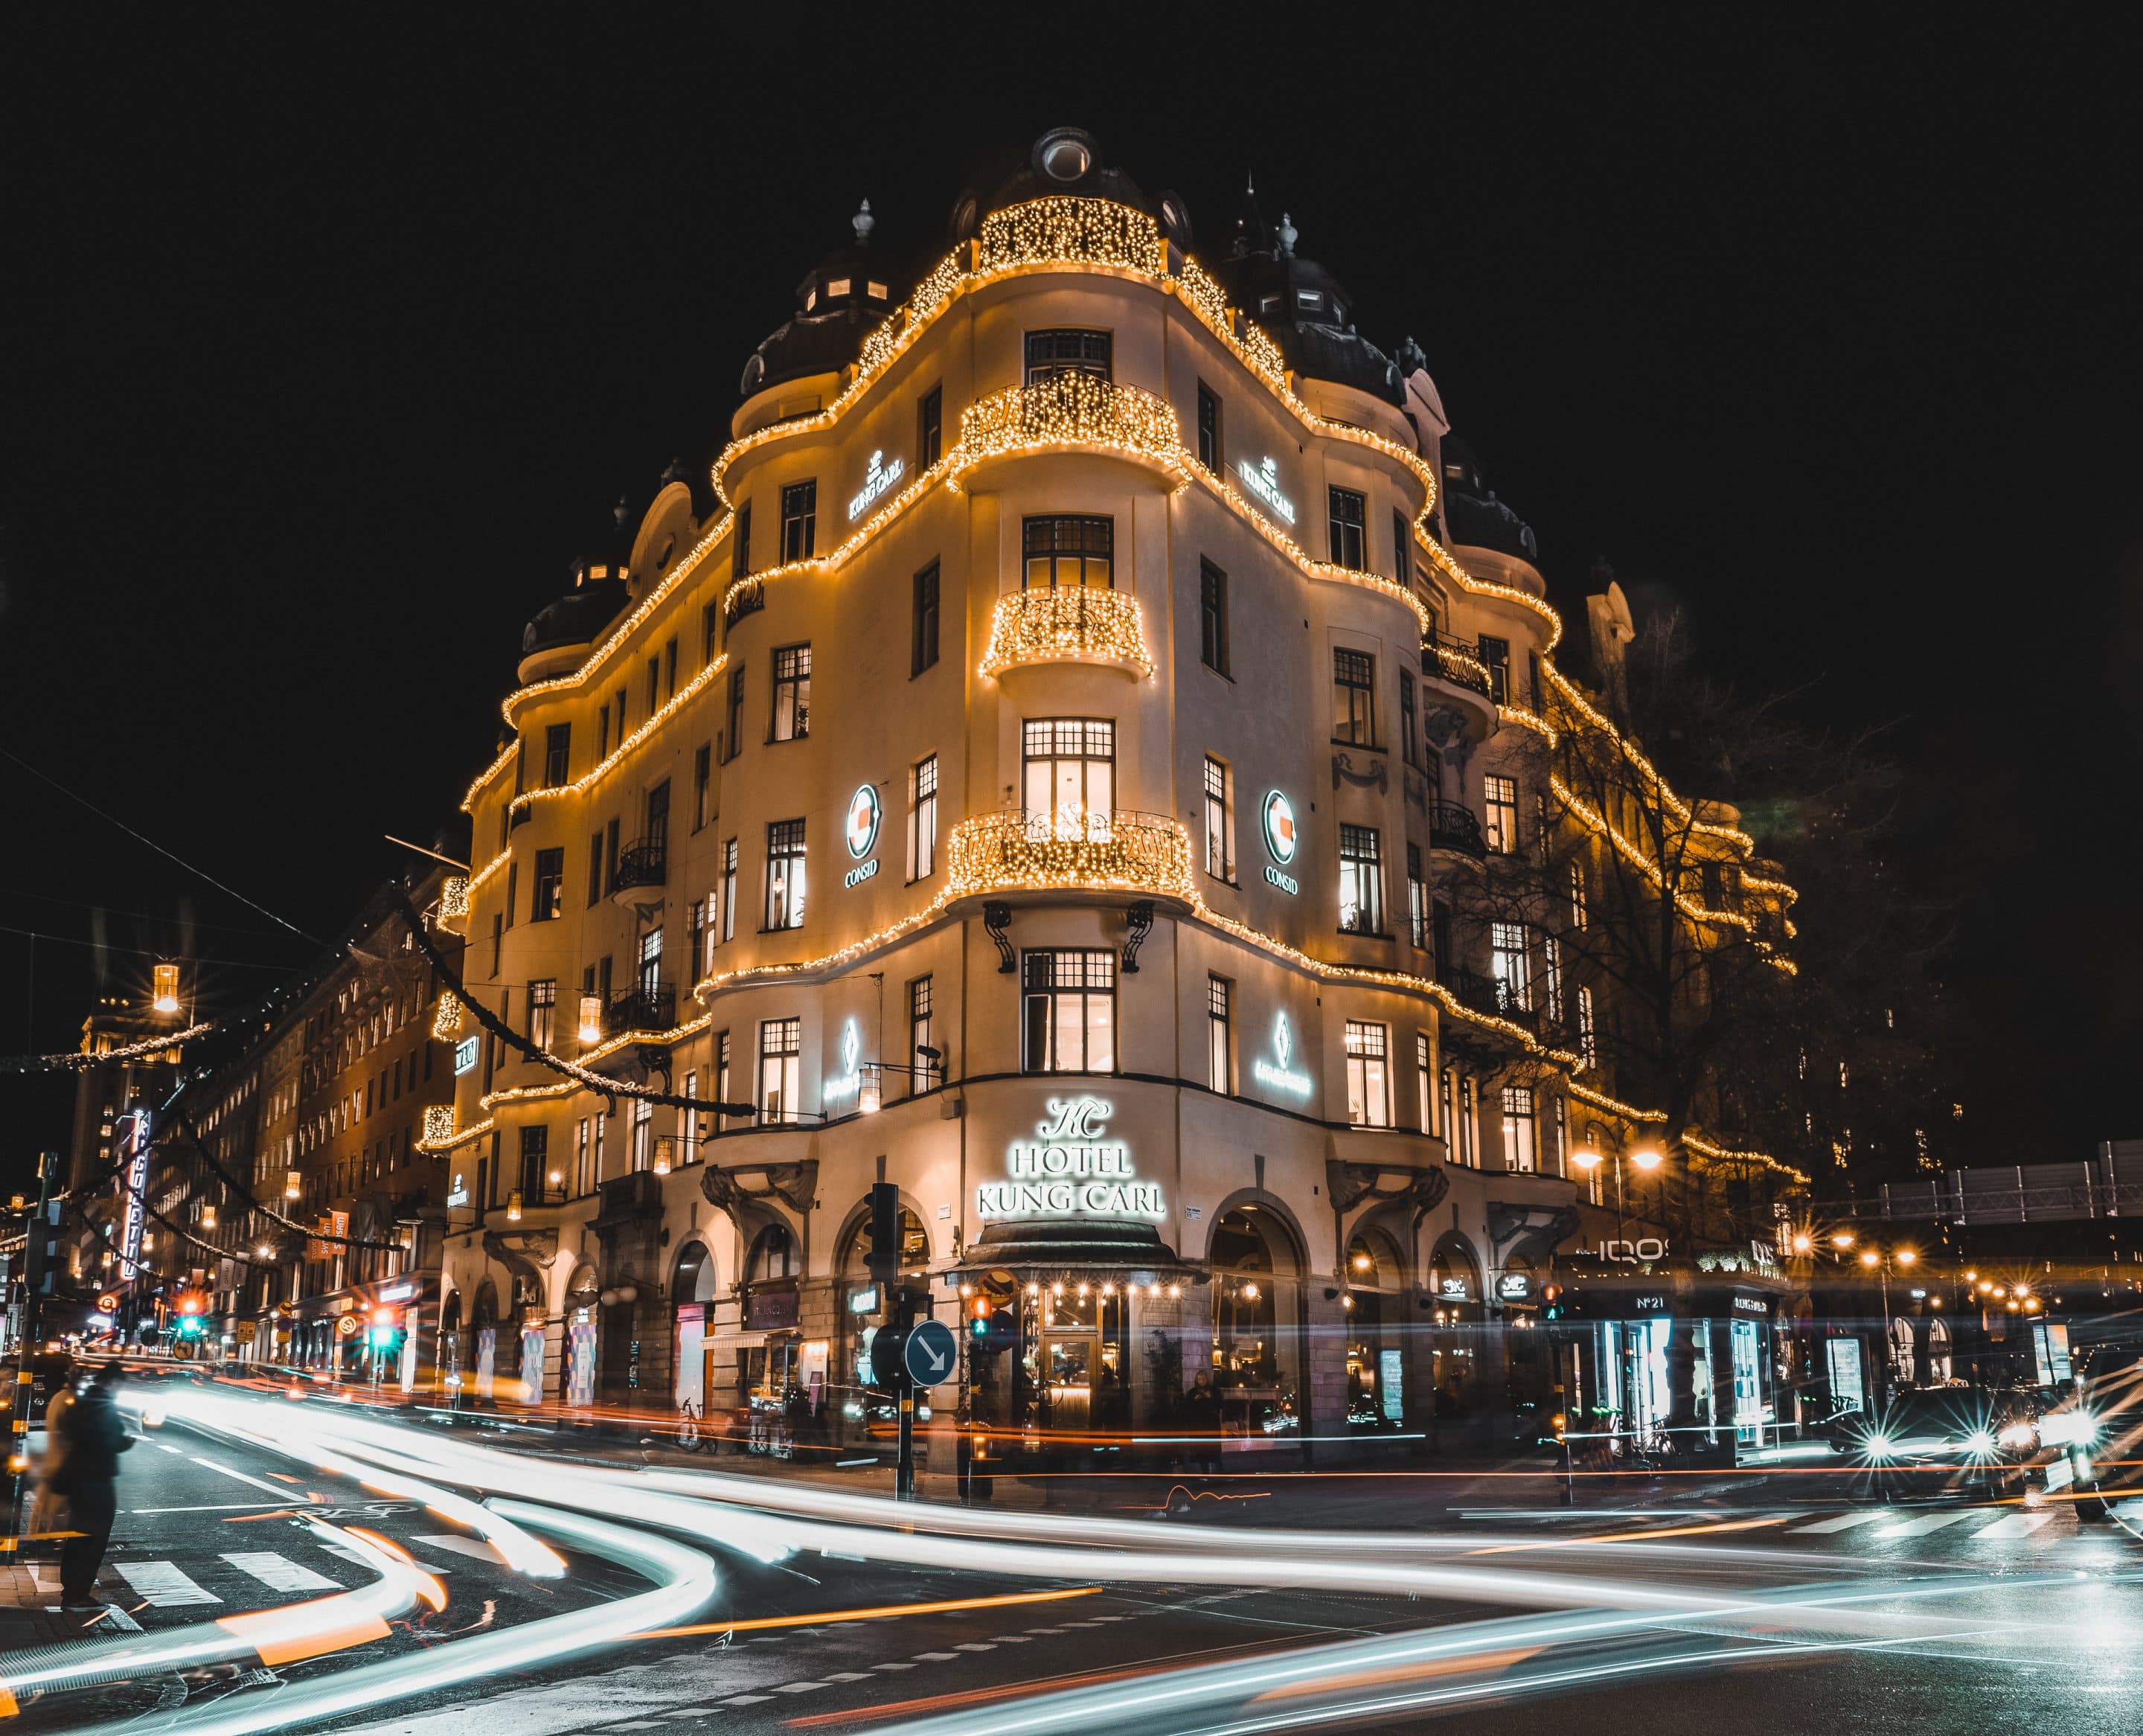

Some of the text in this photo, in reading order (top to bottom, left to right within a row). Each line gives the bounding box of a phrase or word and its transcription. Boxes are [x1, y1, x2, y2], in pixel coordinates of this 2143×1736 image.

[849, 481, 877, 519] KUNG
[876, 459, 903, 493] CARL
[1240, 462, 1271, 502] KUNG
[1272, 490, 1295, 524] CARL
[845, 859, 878, 888] CONSID
[1266, 865, 1298, 895] CONSID
[1015, 1147, 1132, 1173] HOTEL
[978, 1185, 1071, 1213] KUNG
[1086, 1185, 1165, 1213] CARL
[321, 1223, 332, 1255] SYNAM
[334, 1217, 345, 1249] SSAM
